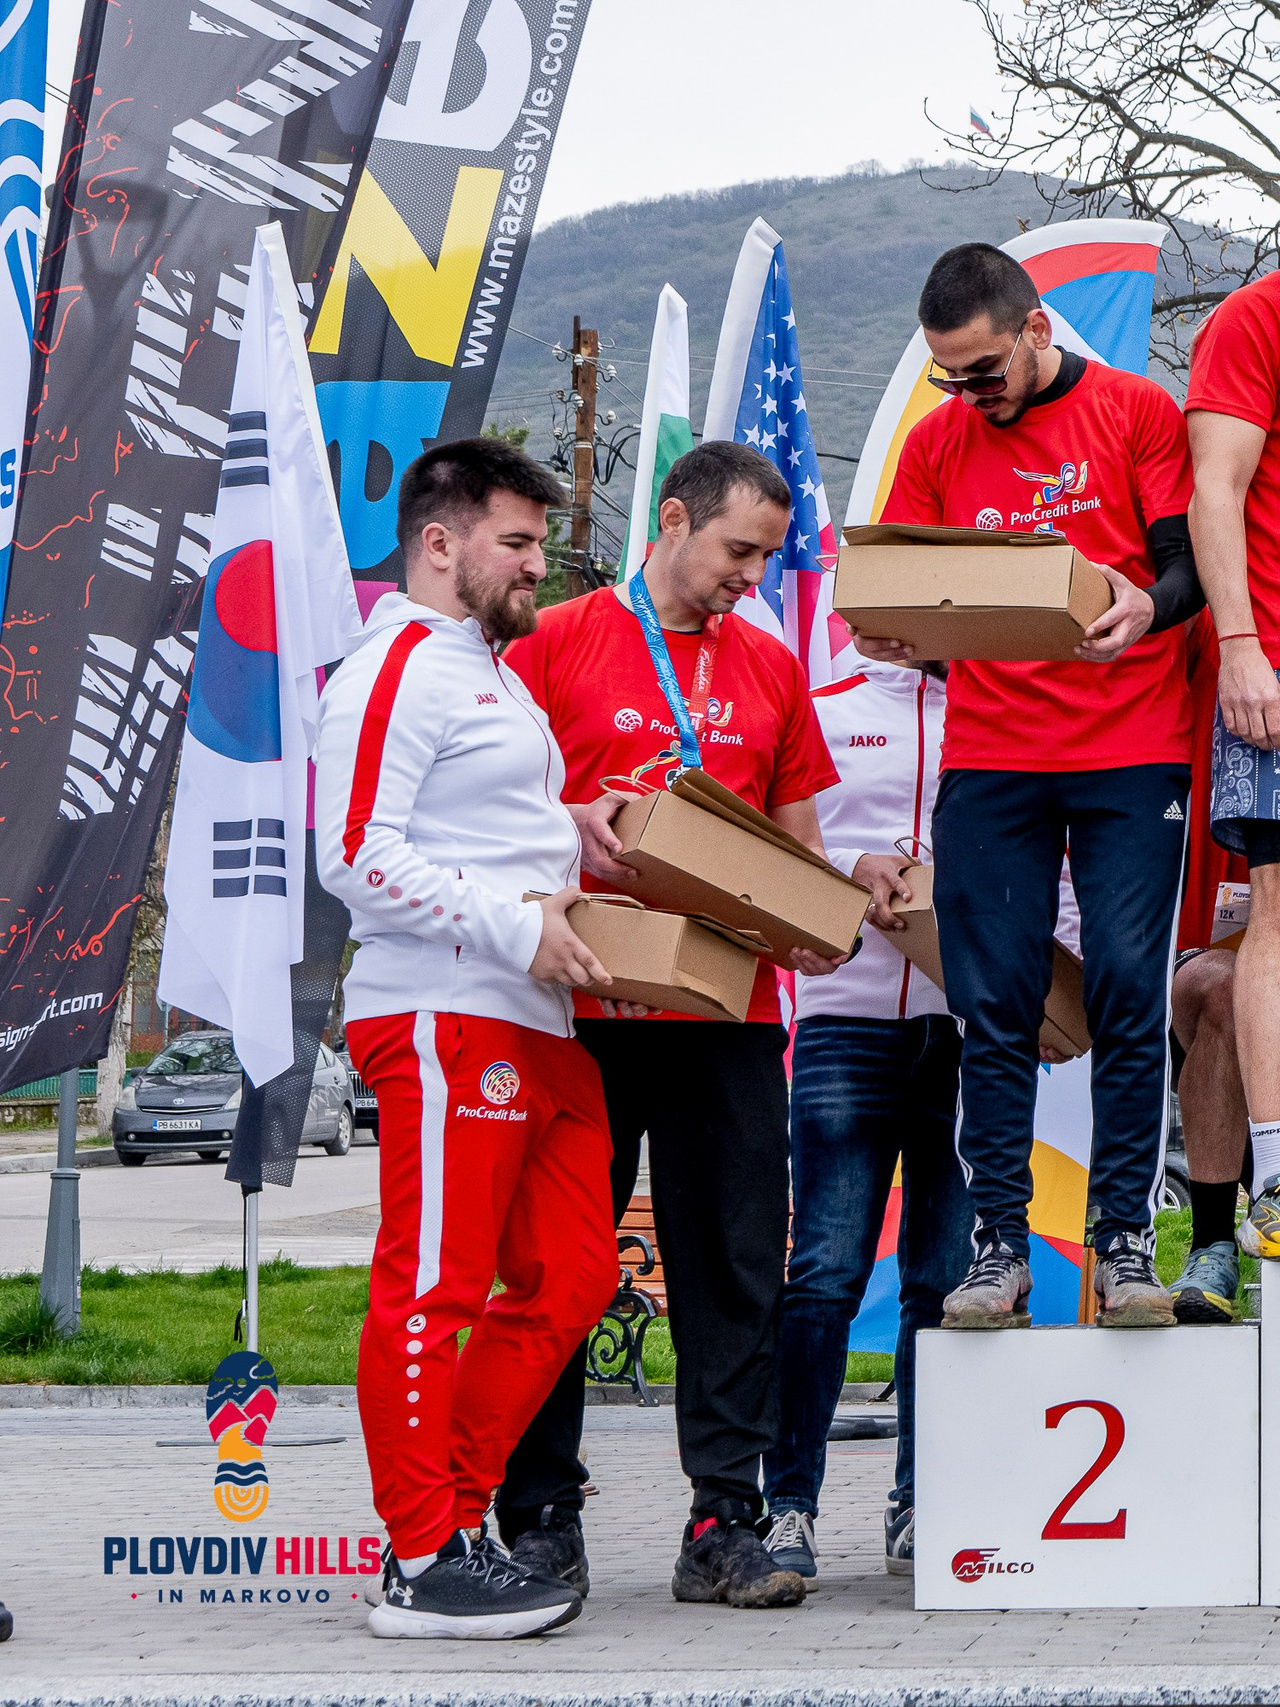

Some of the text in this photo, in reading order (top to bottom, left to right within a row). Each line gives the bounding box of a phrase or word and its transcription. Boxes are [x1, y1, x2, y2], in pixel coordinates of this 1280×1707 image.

[460, 0, 579, 369] www.mazestyle.com
[1010, 496, 1102, 526] ProCredit Bank
[474, 693, 499, 705] JAKO
[709, 732, 744, 746] Bank
[848, 735, 888, 747] JAKO
[1163, 811, 1184, 821] adidas
[1219, 909, 1235, 920] 12K
[456, 1105, 528, 1121] ProCredit Bank
[169, 1121, 187, 1129] 6631
[1039, 1398, 1128, 1542] 2
[955, 1561, 1035, 1577] MILCO
